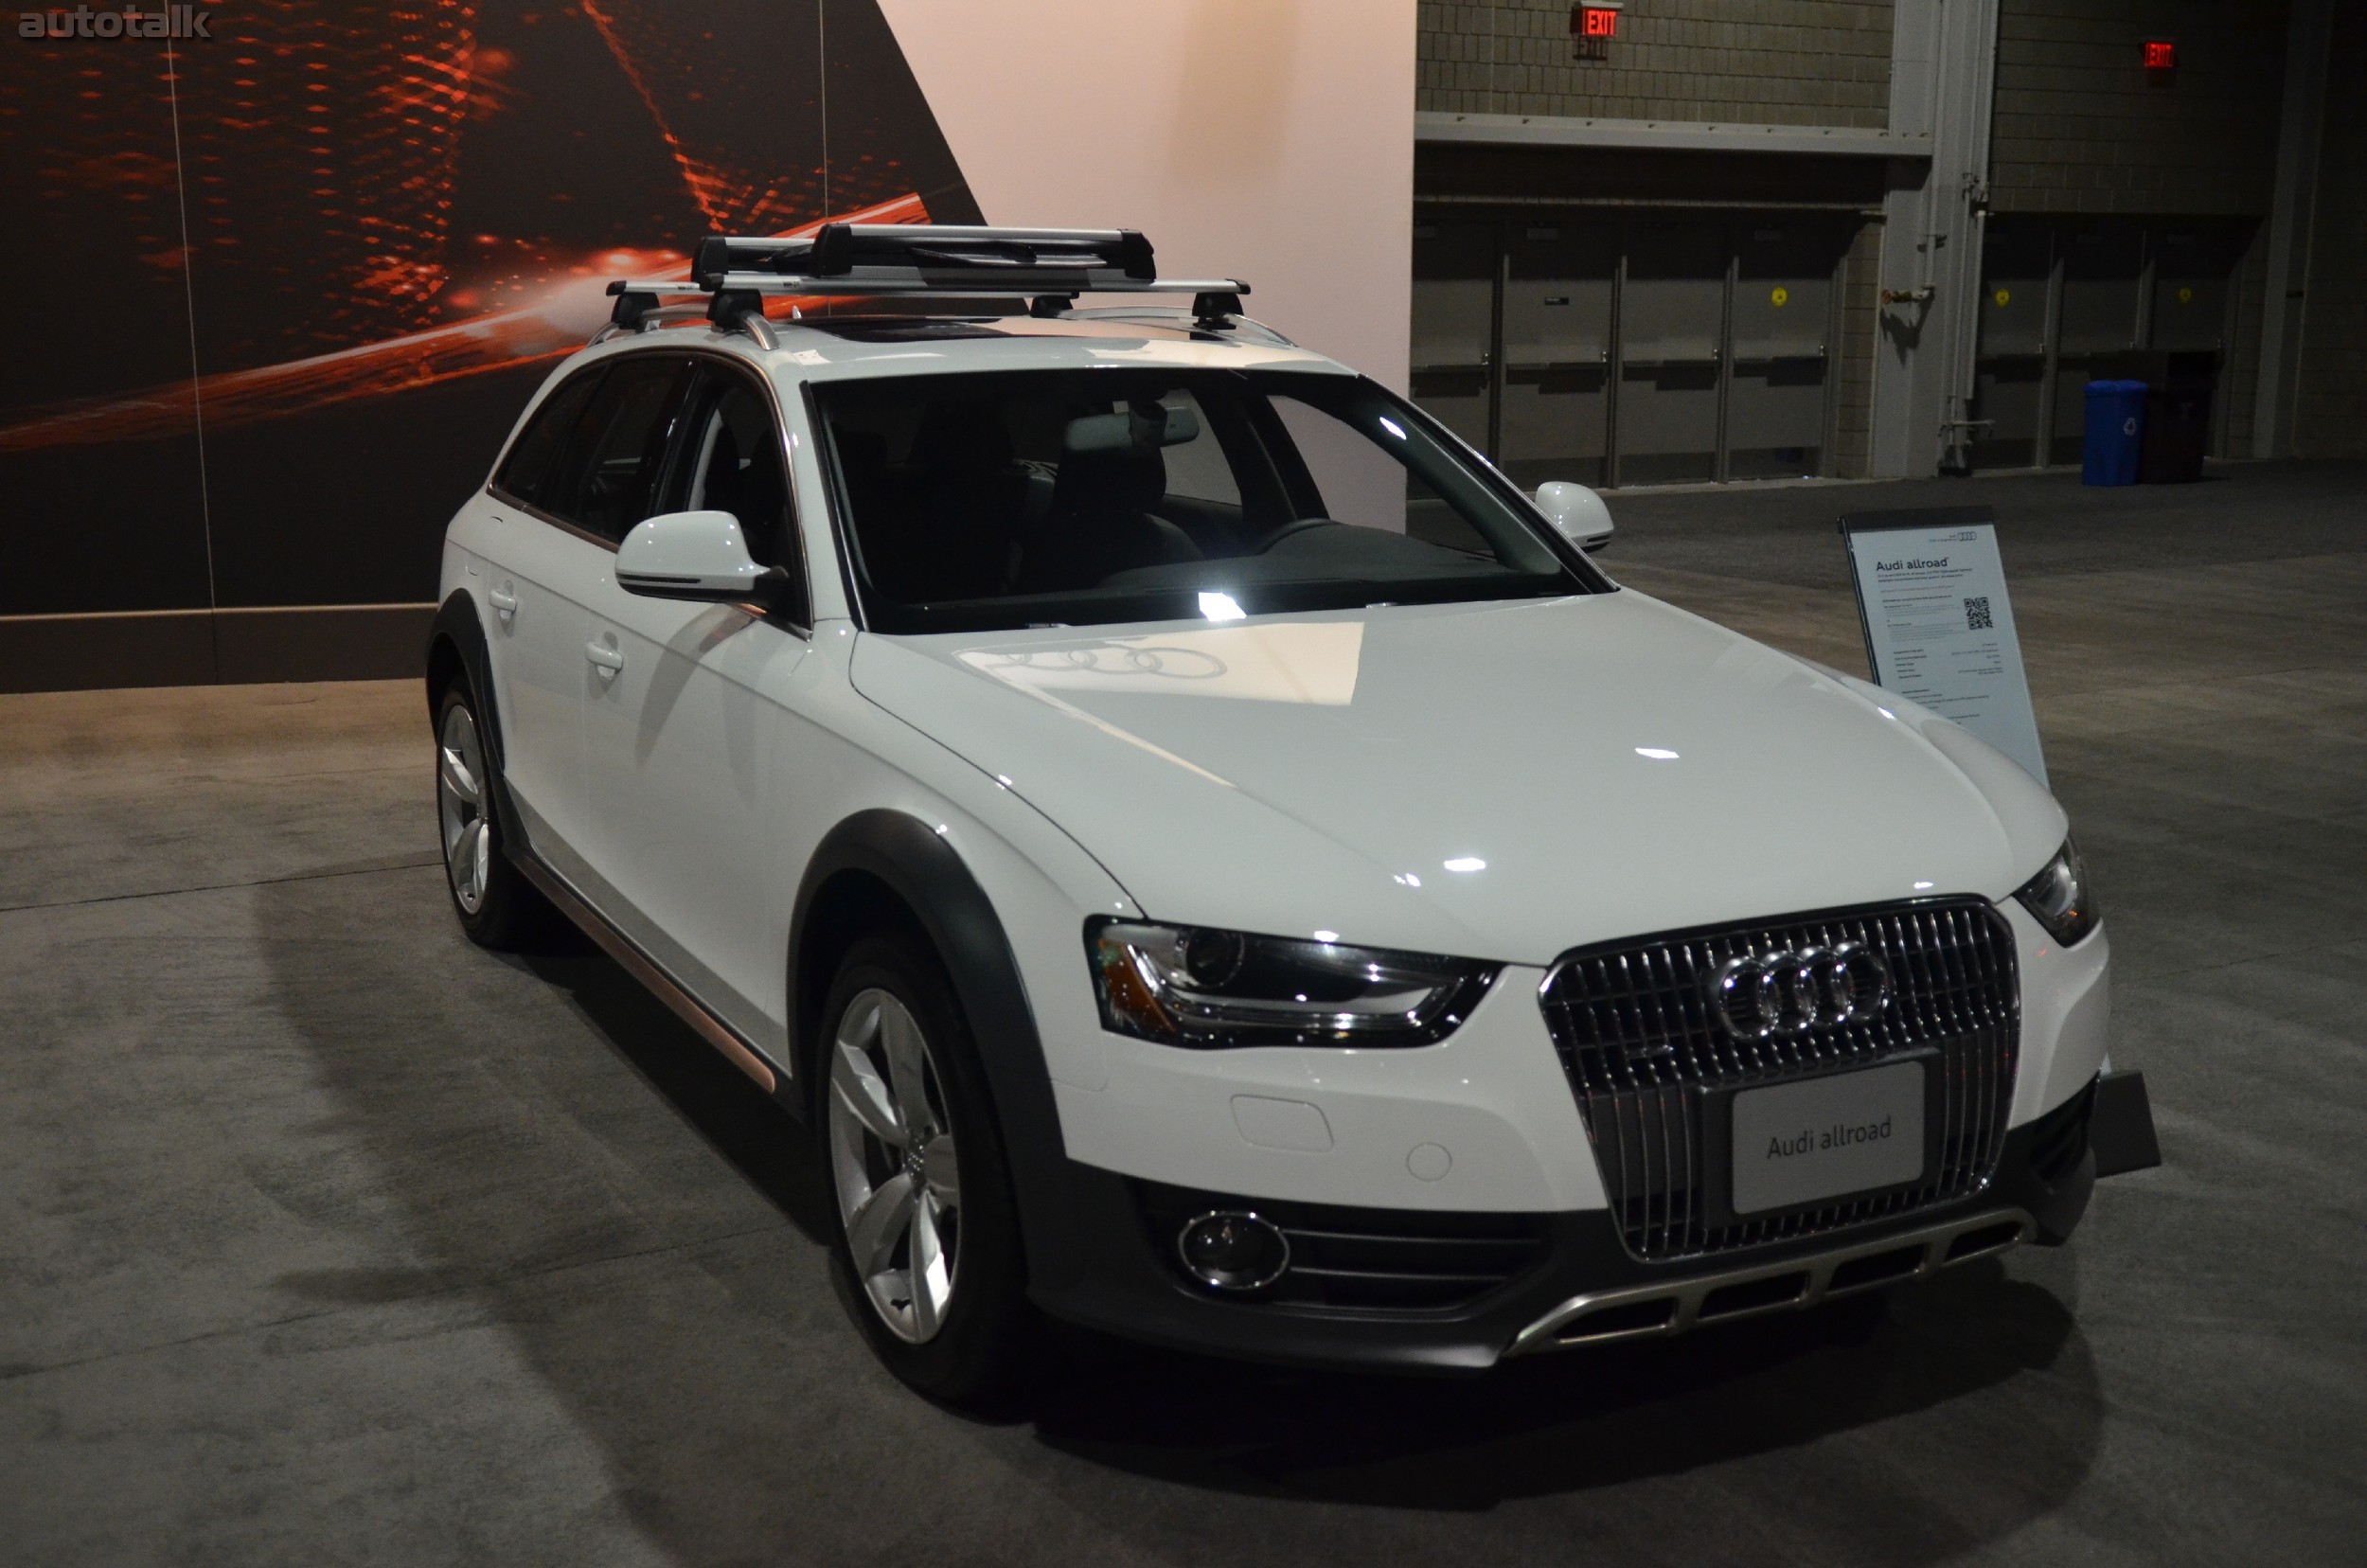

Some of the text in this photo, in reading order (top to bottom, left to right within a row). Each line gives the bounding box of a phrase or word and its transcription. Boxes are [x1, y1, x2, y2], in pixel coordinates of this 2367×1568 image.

[1588, 9, 1617, 36] EXIT
[2149, 44, 2172, 66] EXIT
[1876, 560, 1903, 572] Audi
[1767, 1114, 1892, 1159] Audi allroad
